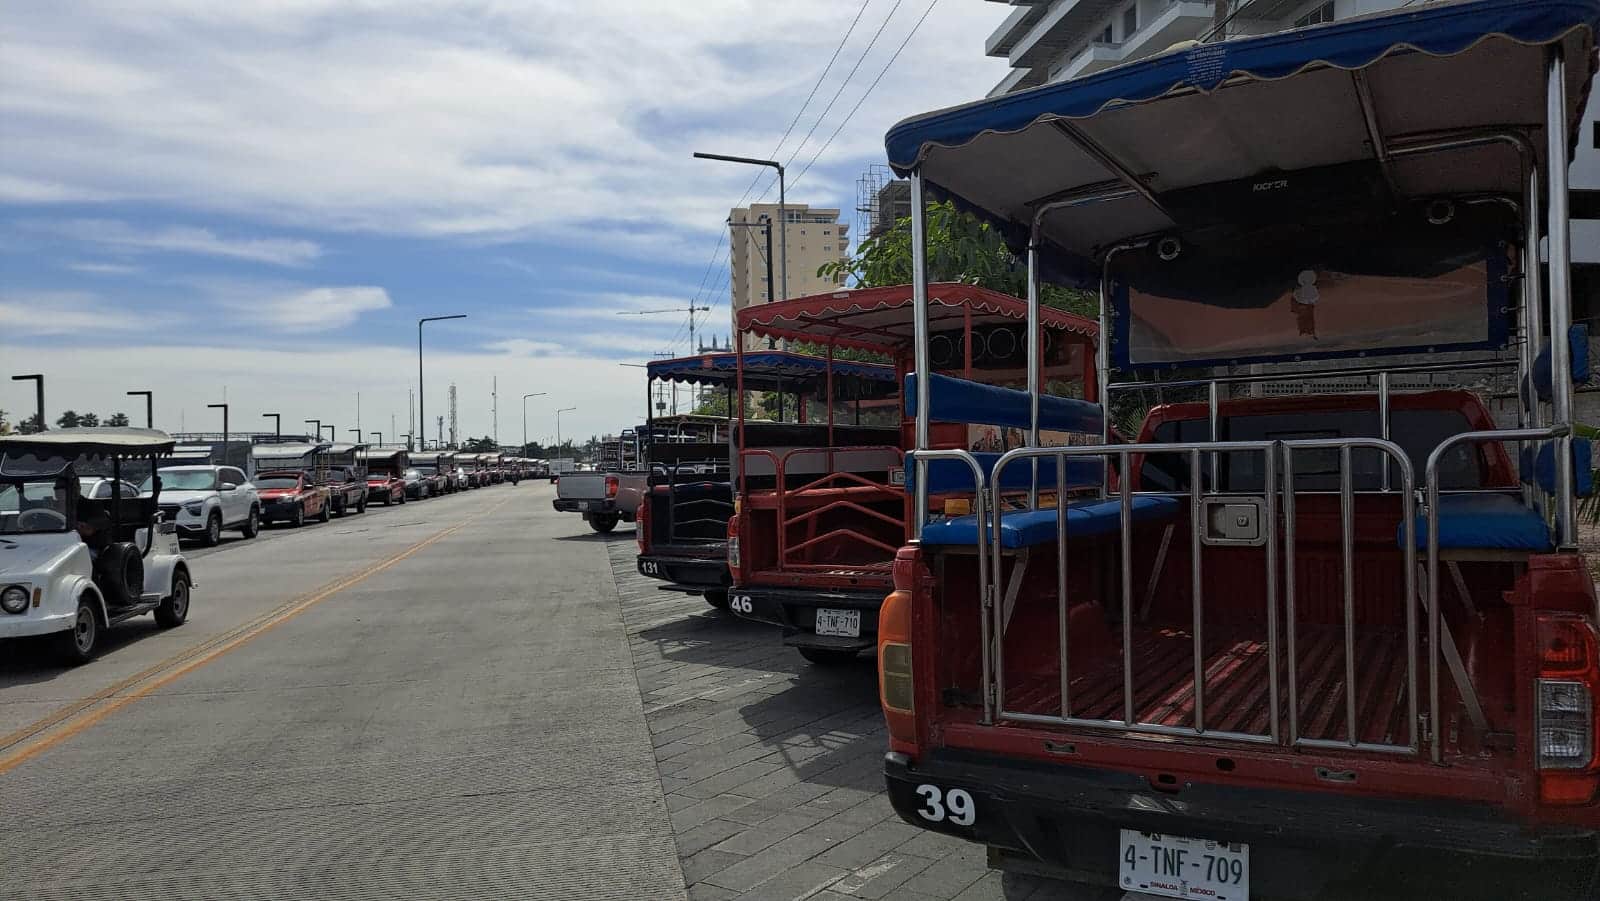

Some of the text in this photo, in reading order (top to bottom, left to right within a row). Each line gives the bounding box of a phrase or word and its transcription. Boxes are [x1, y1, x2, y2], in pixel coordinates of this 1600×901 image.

[641, 561, 658, 574] 131
[731, 595, 752, 613] 46
[916, 784, 976, 826] 39
[1124, 844, 1243, 885] 4-TNF-709
[1150, 881, 1178, 891] SINALOA
